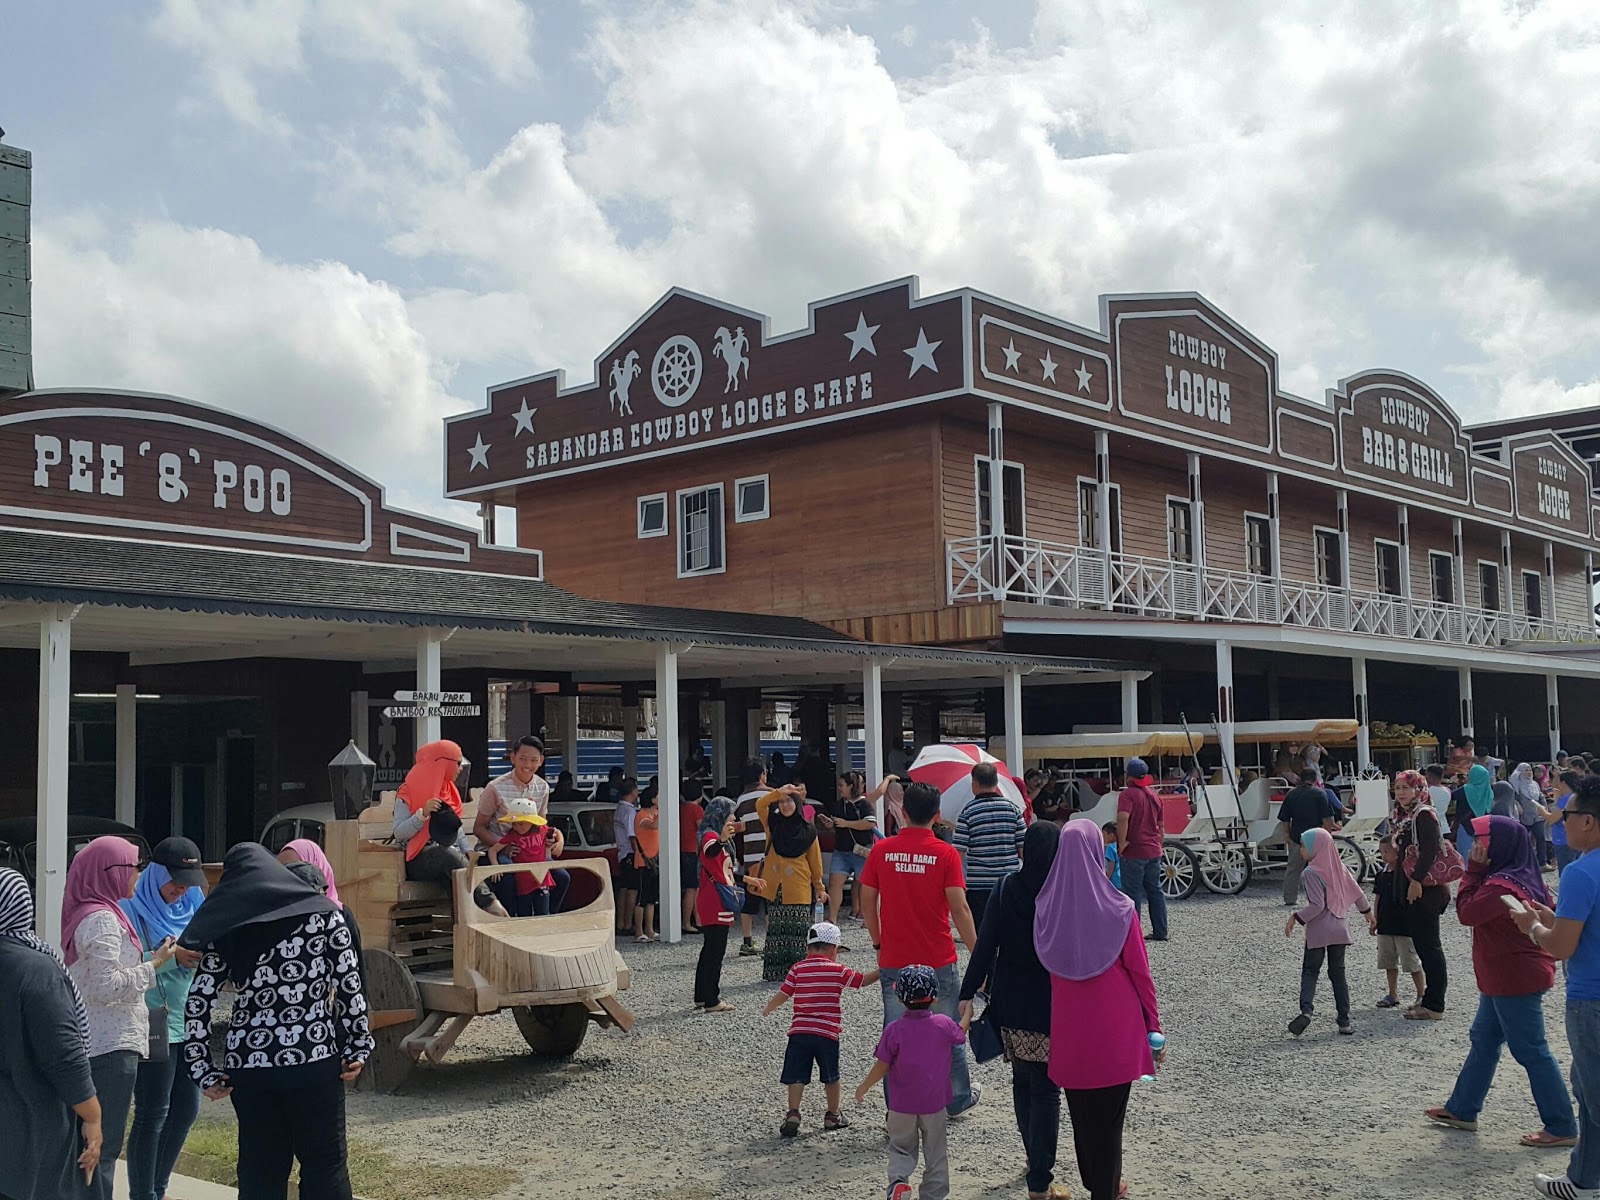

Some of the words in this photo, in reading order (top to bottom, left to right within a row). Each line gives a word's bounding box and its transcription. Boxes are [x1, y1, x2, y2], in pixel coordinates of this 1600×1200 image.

[1168, 329, 1227, 371] COWBOY
[1165, 364, 1232, 425] LODGE
[526, 427, 624, 469] SABANDAR
[630, 408, 714, 448] COWBOY
[721, 391, 787, 430] LODGE
[794, 387, 810, 414] &
[814, 371, 873, 410] CAFE
[1380, 396, 1430, 437] COWBOY
[34, 434, 124, 497] PEE
[213, 459, 291, 516] POO
[1362, 426, 1396, 471] BAR
[1398, 438, 1410, 475] &
[1411, 441, 1454, 488] GRILL
[1538, 456, 1567, 482] COWBOY
[1537, 482, 1571, 521] LODGE
[390, 707, 425, 717] BAMBOO
[427, 706, 478, 717] RESTAURANT
[412, 691, 439, 701] BAKAU
[442, 692, 465, 703] PARK
[885, 852, 911, 863] PANTAI
[912, 853, 937, 866] BARAT
[895, 863, 925, 874] SELATAN
